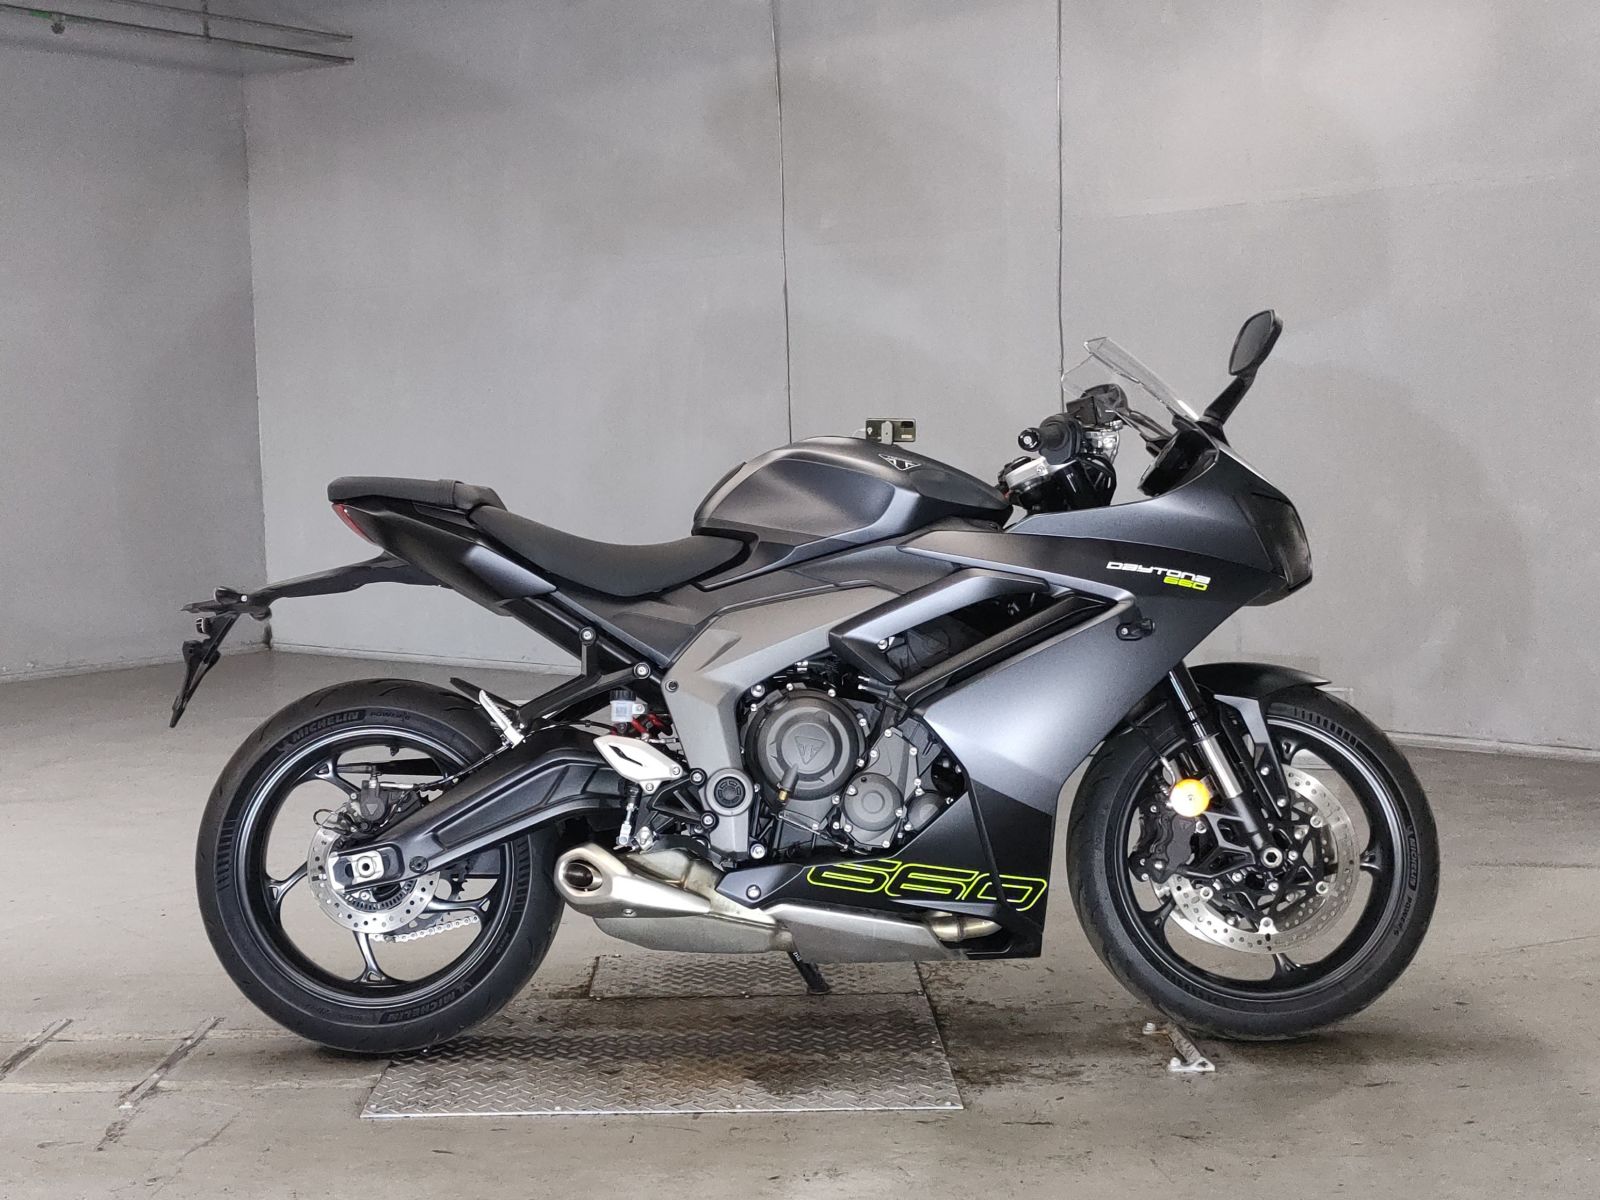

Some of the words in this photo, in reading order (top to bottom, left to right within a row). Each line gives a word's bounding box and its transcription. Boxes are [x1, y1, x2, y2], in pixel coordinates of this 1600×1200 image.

[1163, 576, 1208, 591] 660
[293, 711, 360, 742] MICHELIN
[1408, 838, 1418, 889] MICHELIN
[807, 859, 1047, 912] 660
